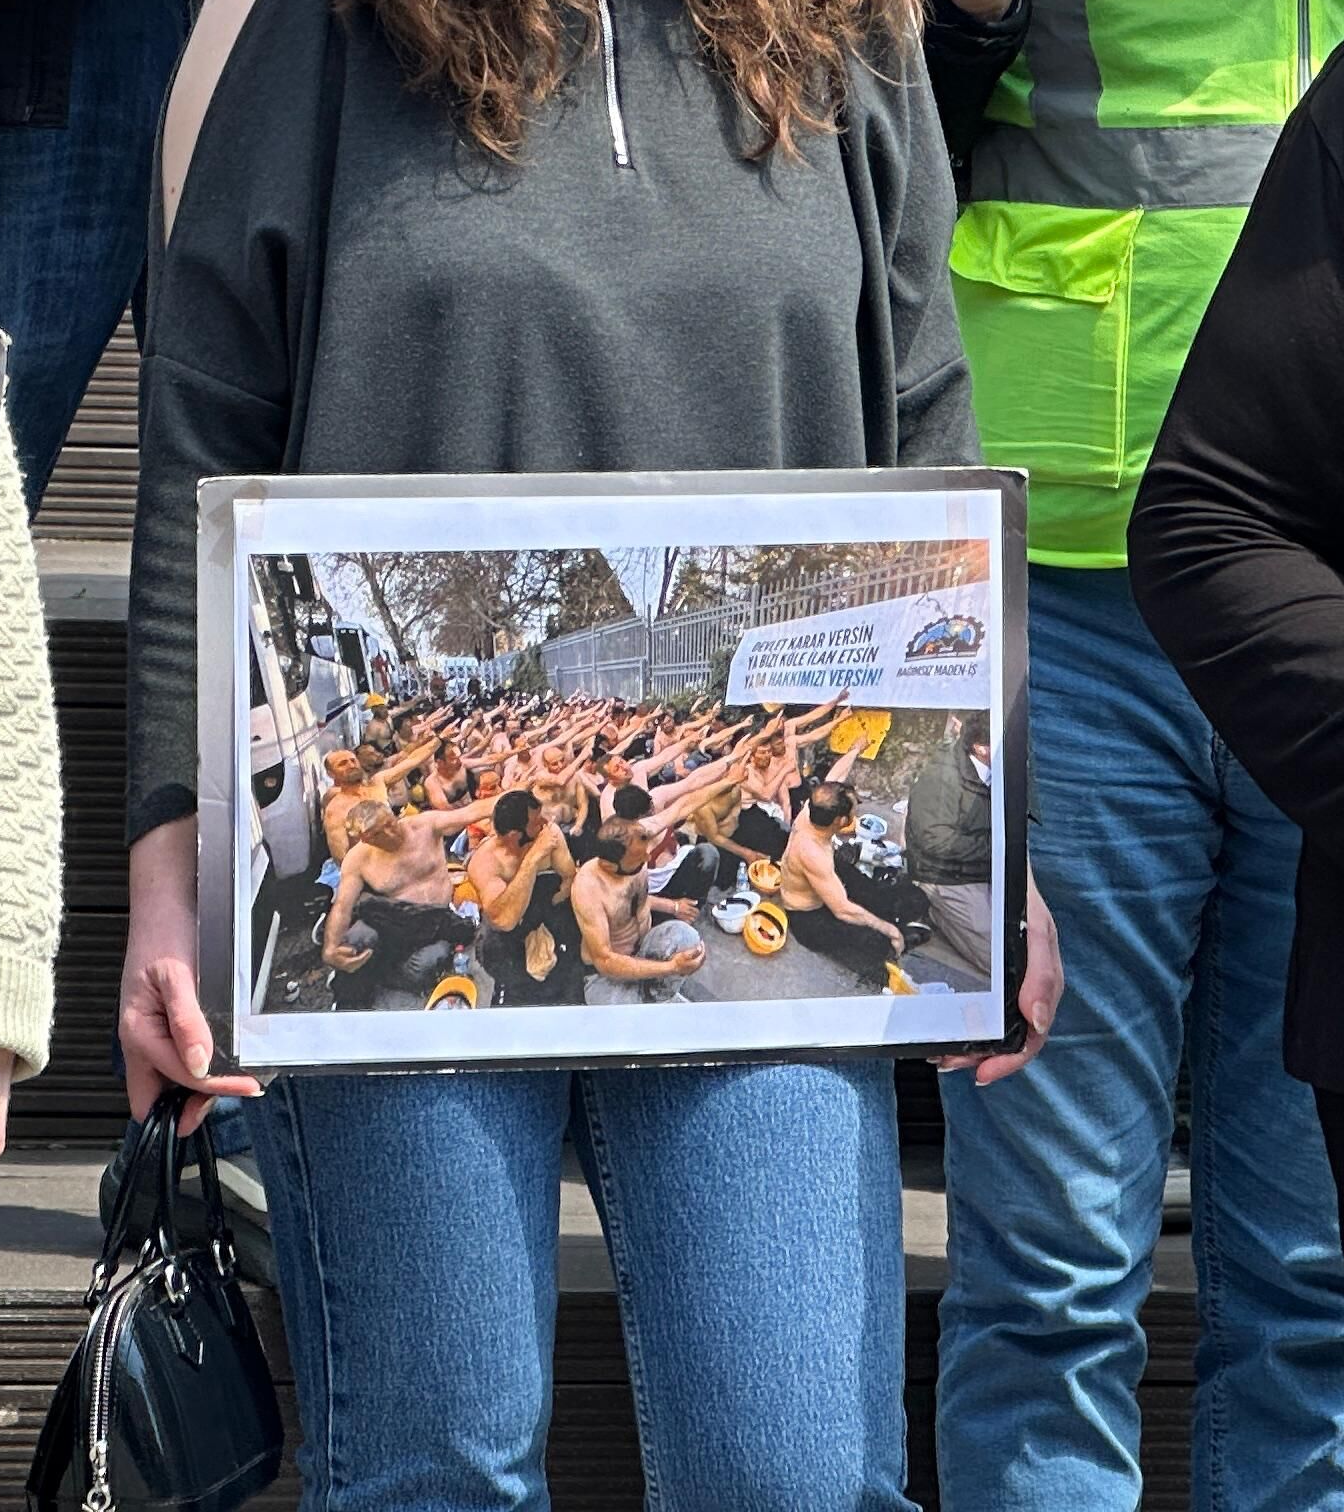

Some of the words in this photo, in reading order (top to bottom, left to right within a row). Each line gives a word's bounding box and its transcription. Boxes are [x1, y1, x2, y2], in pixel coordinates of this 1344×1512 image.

[752, 638, 788, 652] DEVLET
[788, 632, 826, 650] KARAR
[829, 620, 874, 647] VERSİN
[748, 654, 758, 670] YA
[837, 643, 879, 664] ETSİN
[768, 670, 826, 687] HAKKIMIZI
[829, 664, 883, 687] VERSİN!
